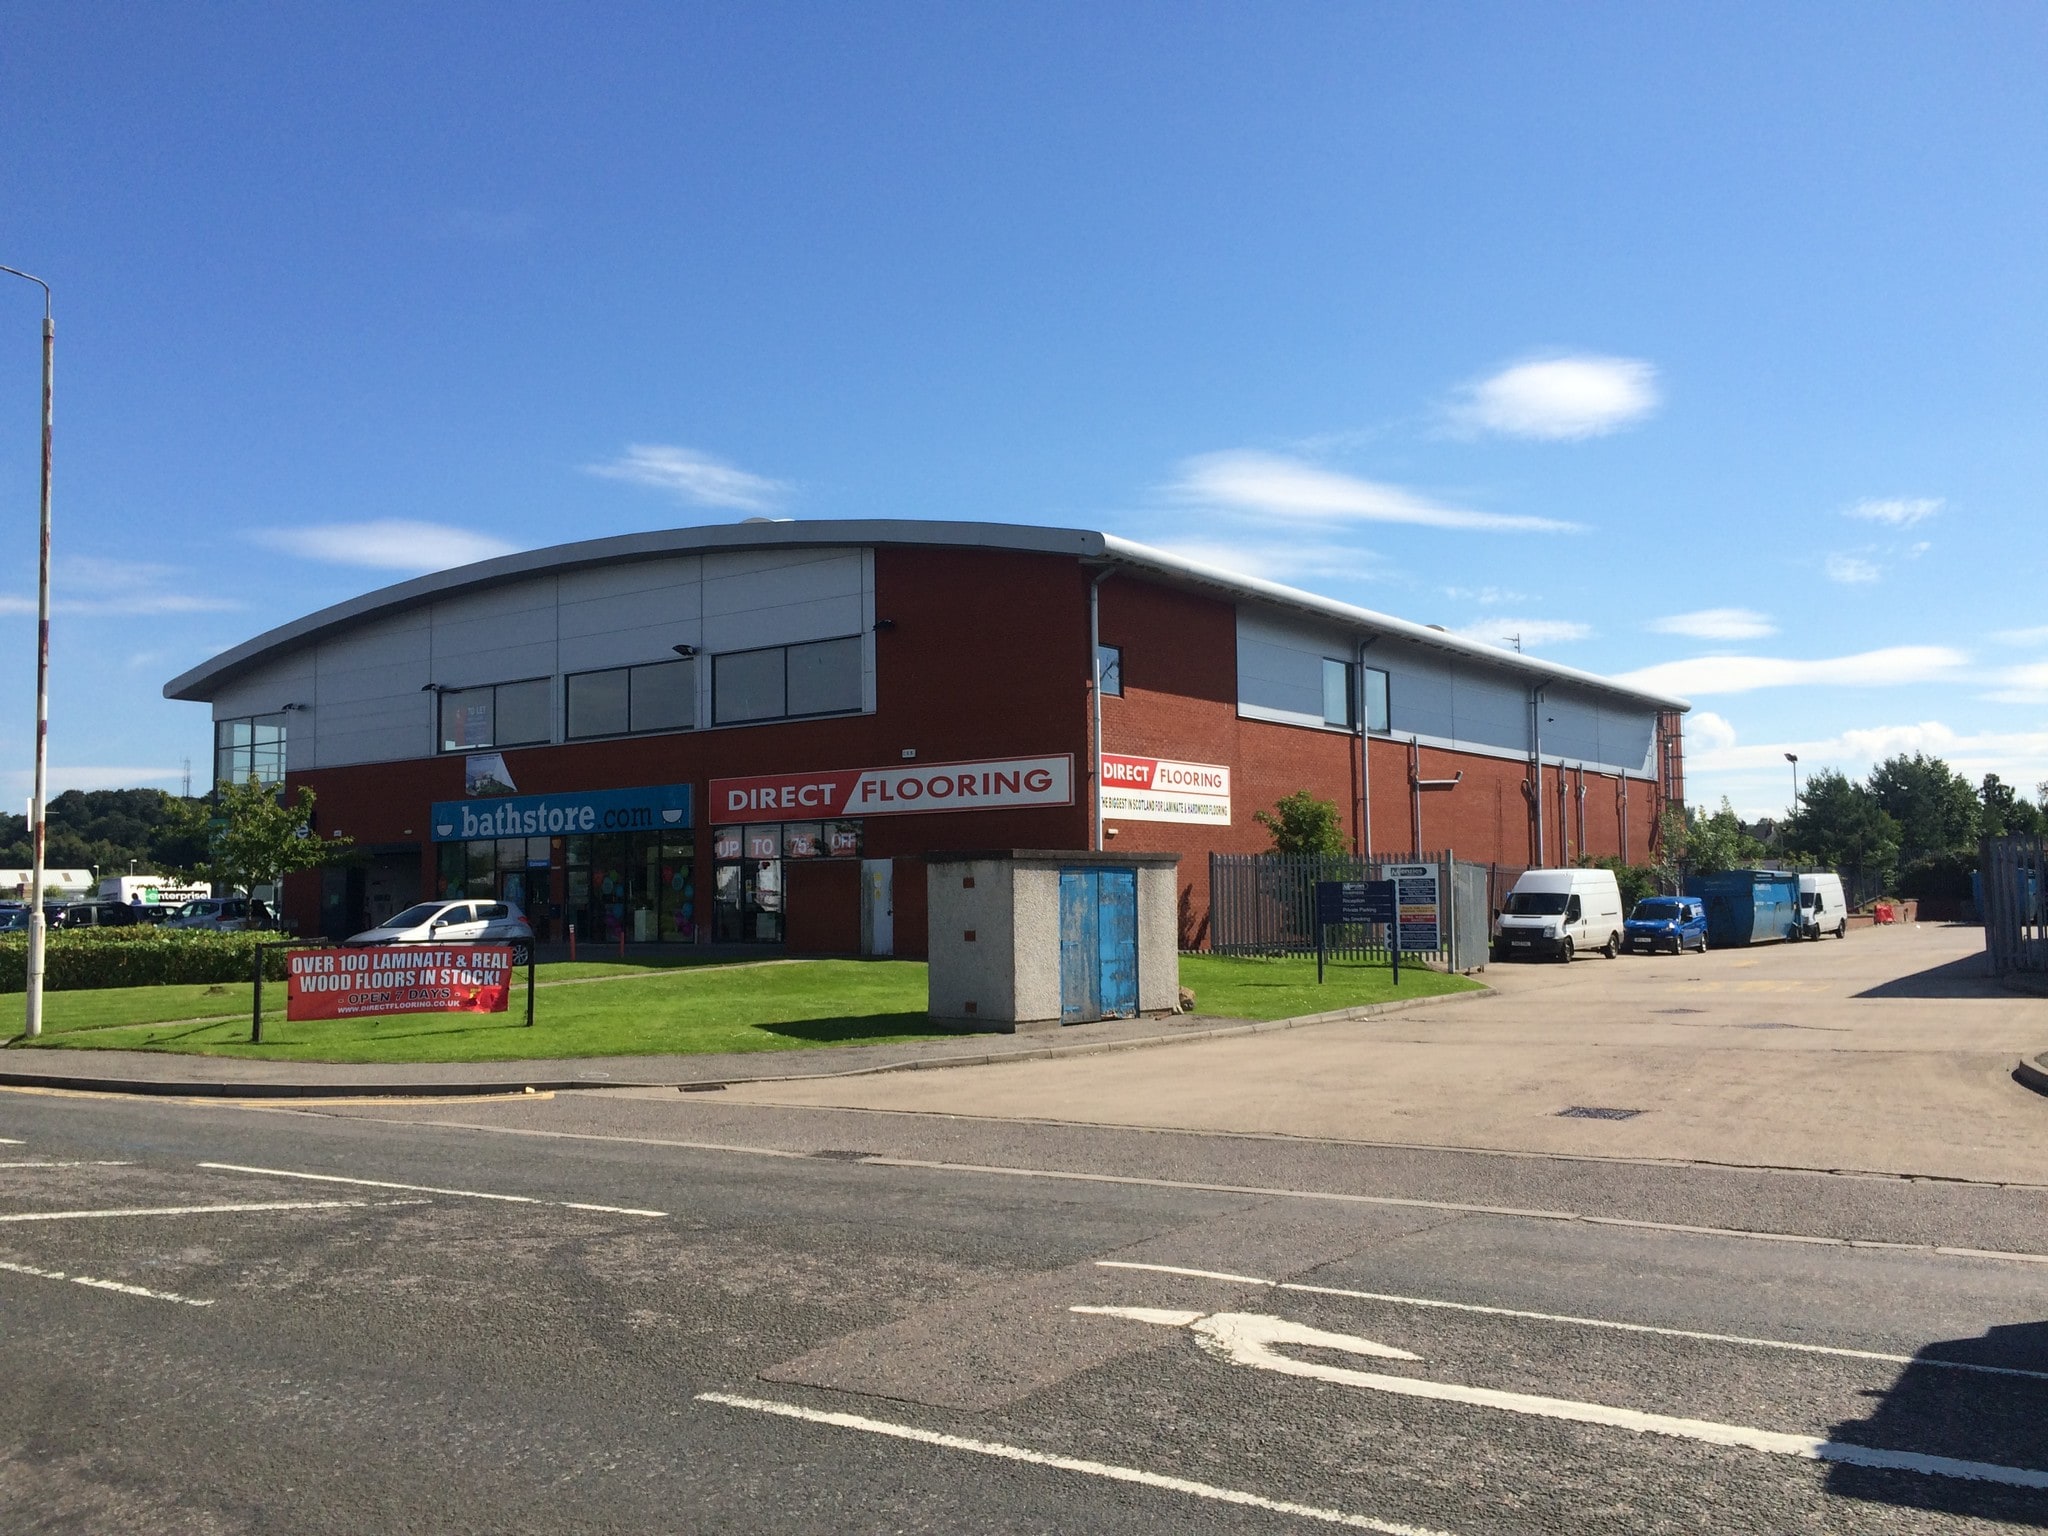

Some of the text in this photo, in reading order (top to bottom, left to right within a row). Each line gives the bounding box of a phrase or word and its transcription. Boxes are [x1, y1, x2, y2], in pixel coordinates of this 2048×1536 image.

[1103, 762, 1222, 788] DIRECT FLOORING
[728, 769, 1053, 811] DIRECT FLOORING
[1109, 796, 1127, 810] BIGGEST
[1128, 797, 1133, 810] IN
[1133, 798, 1155, 812] SCOTLAND
[1163, 801, 1184, 814] LAMINATE
[1187, 802, 1209, 816] HARDWOOD
[1209, 804, 1228, 817] FLOORING
[719, 840, 739, 857] UP
[752, 838, 774, 855] TO
[831, 833, 856, 849] OFF
[149, 891, 208, 902] enterprise
[292, 952, 508, 974] OVER 100 LAMINATE & REAL
[300, 970, 500, 993] WOOD FLOORS IN STOCK!
[348, 992, 391, 1005] OPEN
[395, 990, 404, 1000] 7
[408, 988, 451, 1000] DAYS
